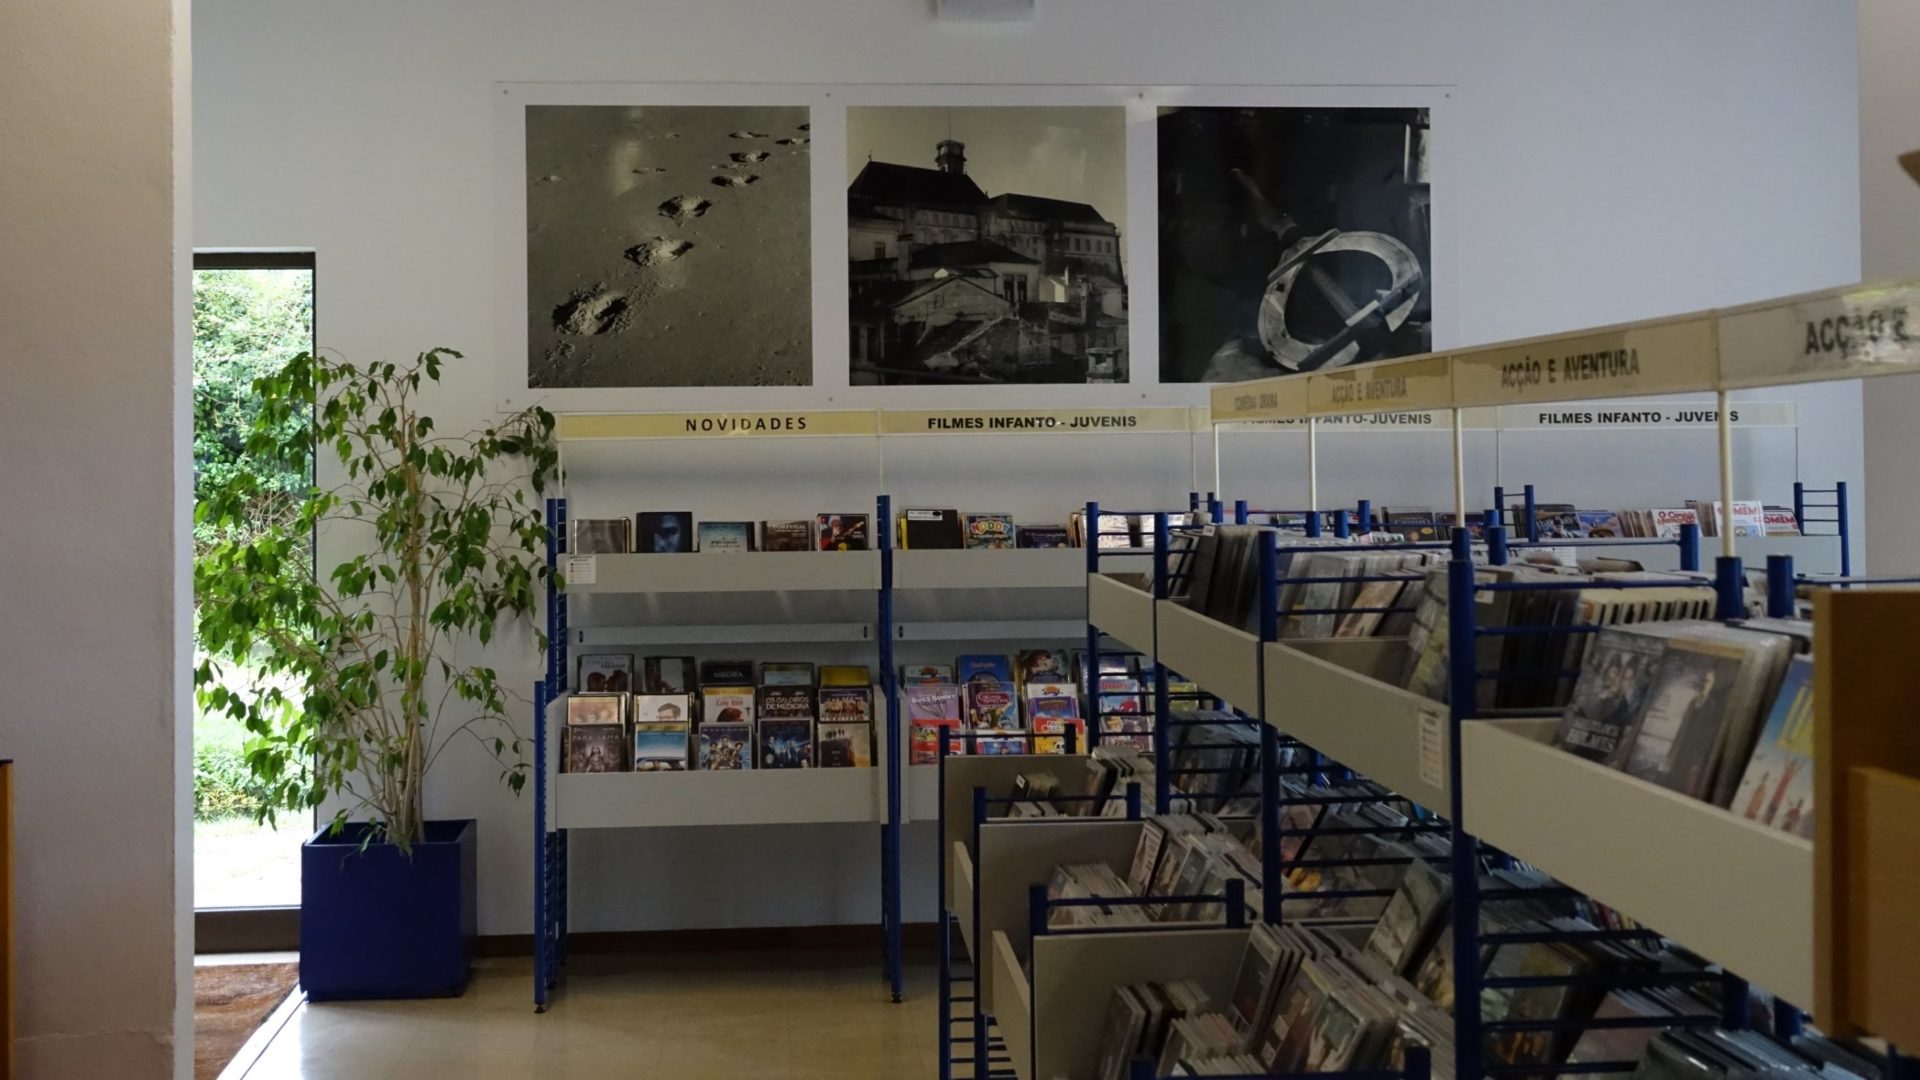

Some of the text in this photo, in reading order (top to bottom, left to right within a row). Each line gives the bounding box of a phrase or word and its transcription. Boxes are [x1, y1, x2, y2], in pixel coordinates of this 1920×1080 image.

[1502, 348, 1640, 392] ACÇÃO E AVENTURA
[686, 417, 807, 431] NOVIDADES
[928, 417, 984, 429] FILMES
[989, 416, 1056, 428] INFANTO
[1070, 416, 1137, 428] JUVENIS
[1370, 413, 1432, 424] JUVENIS
[1539, 413, 1593, 424] FILMES
[1598, 412, 1662, 424] INFANTO
[1675, 411, 1740, 423] JUVENS
[970, 519, 1010, 534] NODDY
[911, 696, 931, 704] BUGS
